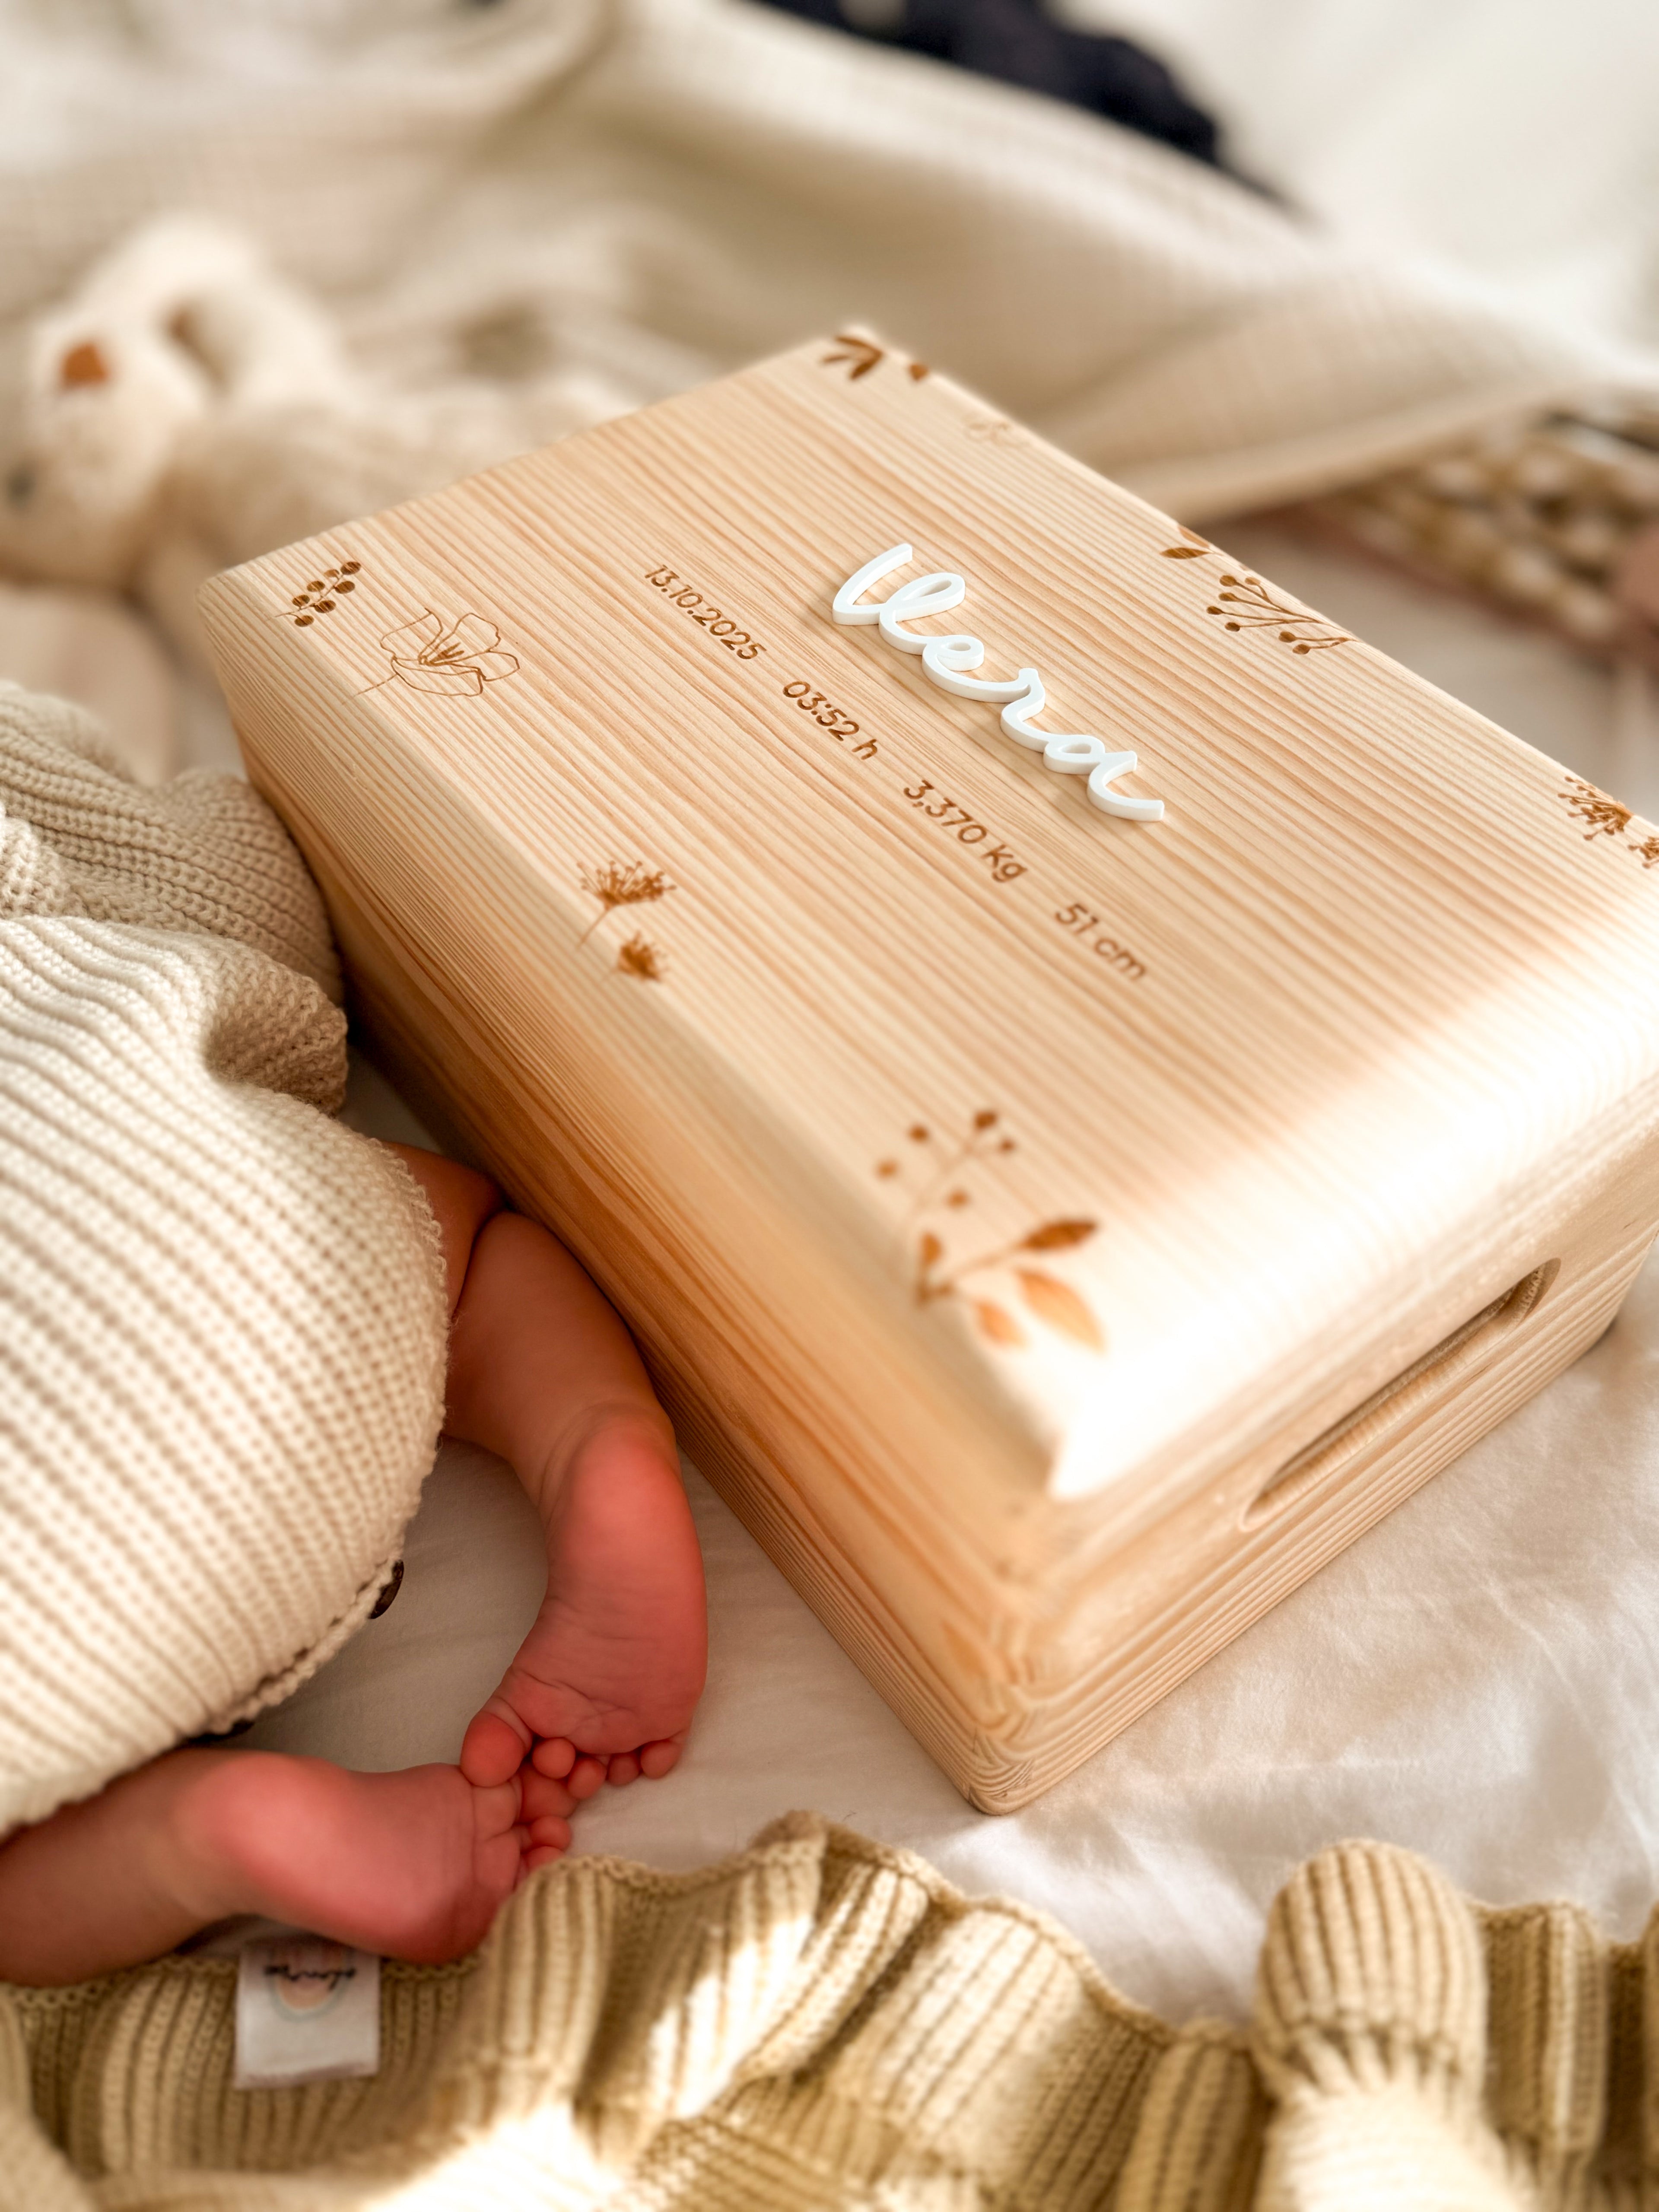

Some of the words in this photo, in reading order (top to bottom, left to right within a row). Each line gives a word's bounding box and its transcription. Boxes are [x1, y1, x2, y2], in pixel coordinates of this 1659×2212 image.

[645, 564, 766, 659] 13.10.2025
[783, 681, 859, 741] 03:52
[852, 739, 877, 760] h
[903, 779, 987, 843] 3,370
[981, 844, 1028, 883] kg
[1055, 903, 1099, 936] 51
[1094, 938, 1147, 982] cm
[833, 543, 1164, 822] Vera
